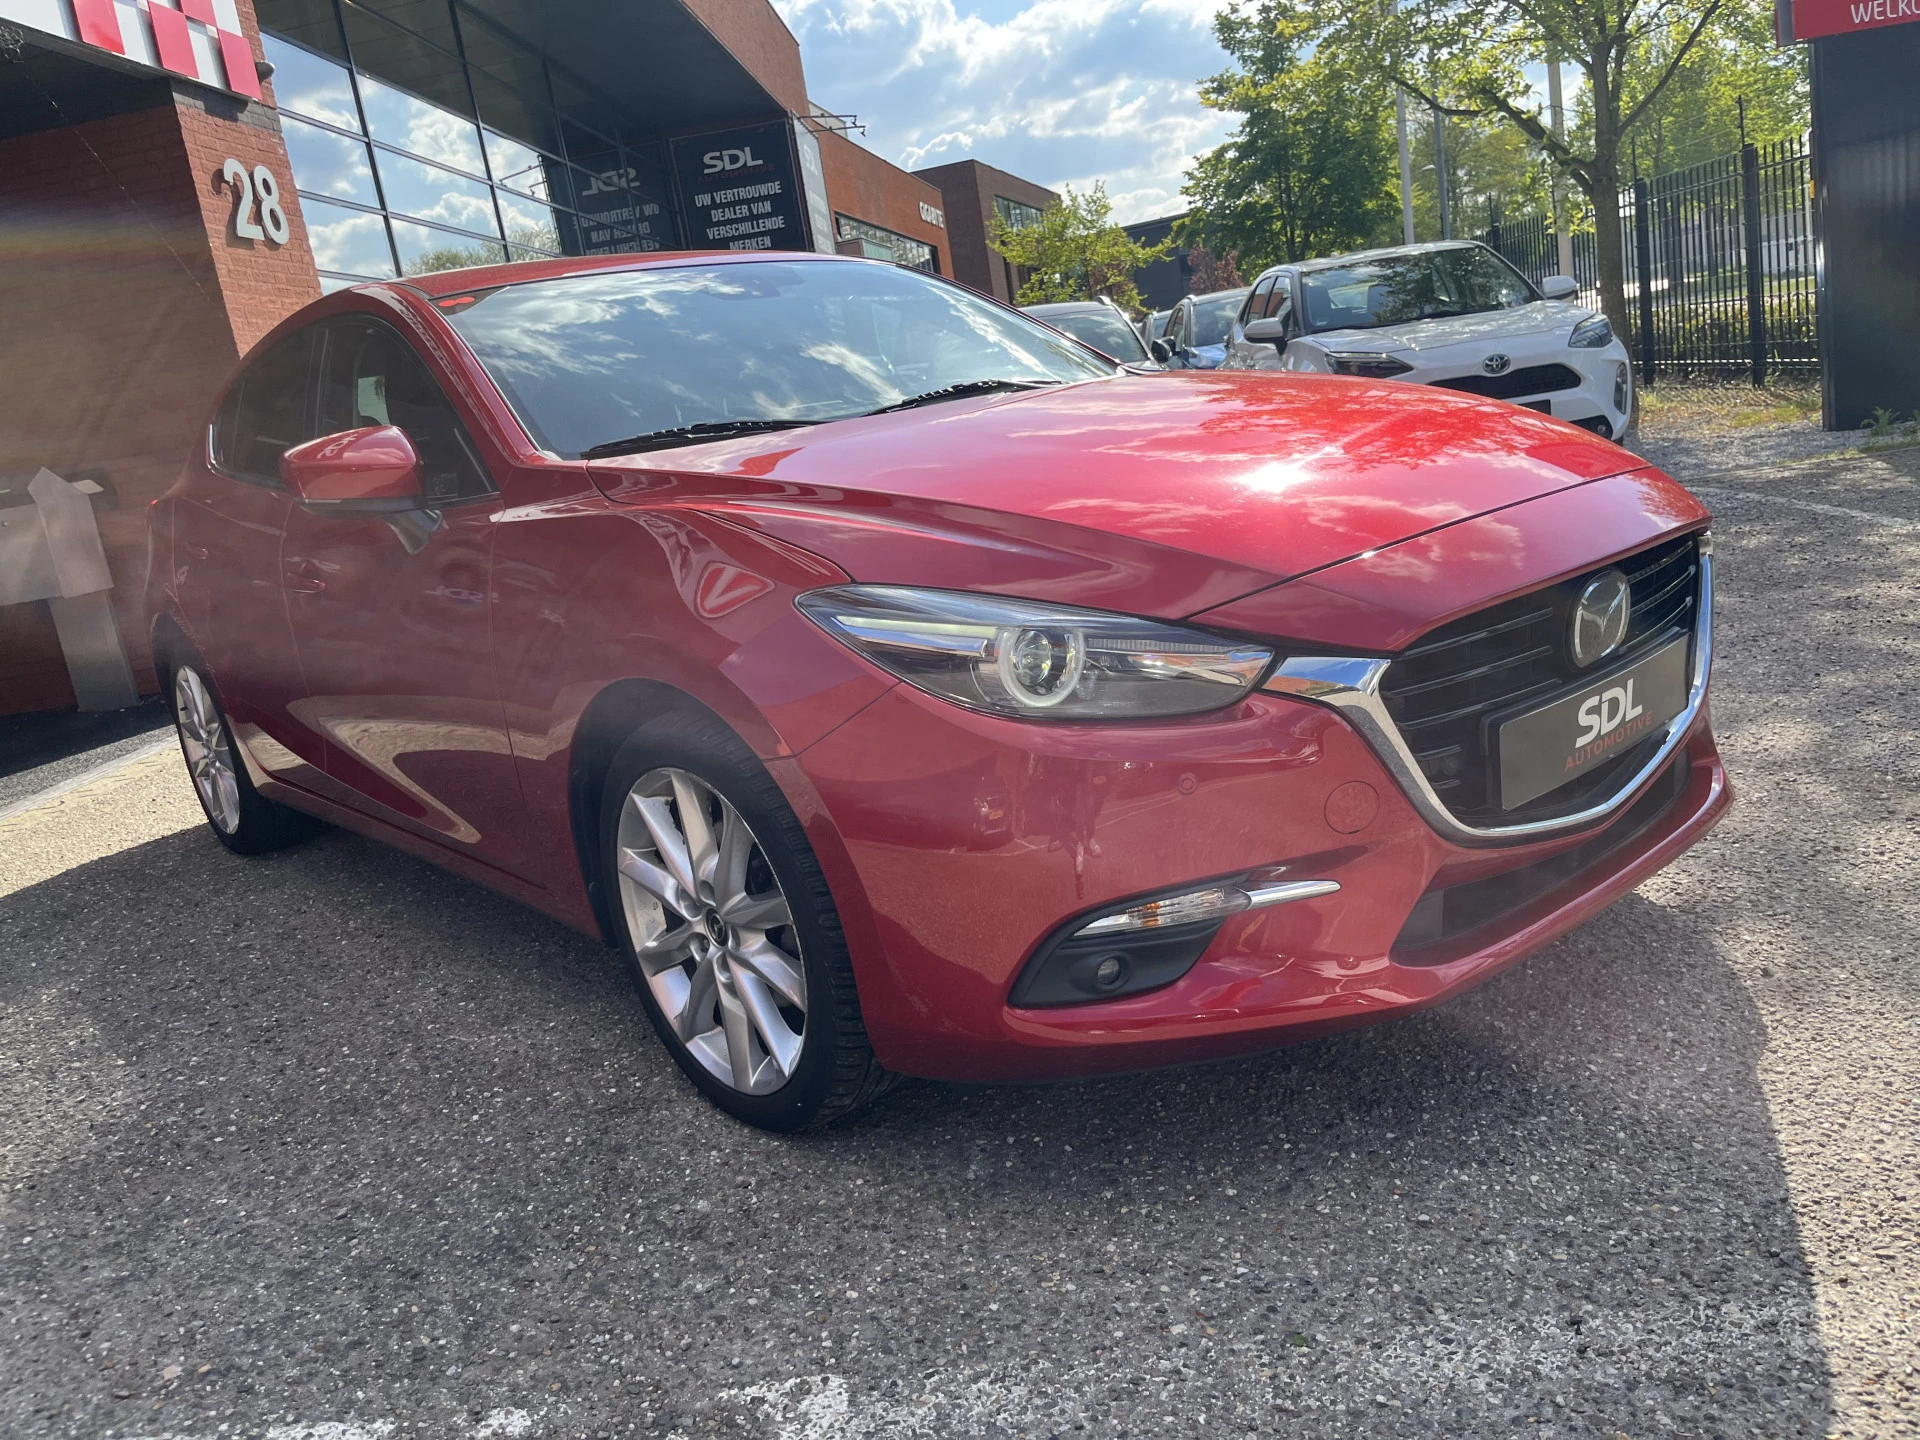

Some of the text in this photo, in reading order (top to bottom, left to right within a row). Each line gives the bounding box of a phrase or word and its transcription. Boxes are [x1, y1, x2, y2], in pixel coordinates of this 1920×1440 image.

[703, 146, 764, 174] SDL
[223, 158, 289, 244] 28
[694, 181, 782, 207] UW VERTROUWDE
[711, 201, 772, 222] DEALER VAN
[706, 216, 785, 240] VERSCHILLENDE
[729, 236, 772, 250] MERKEN
[1575, 678, 1643, 749] SDL
[1564, 711, 1653, 773] AUTOMOTIVE
